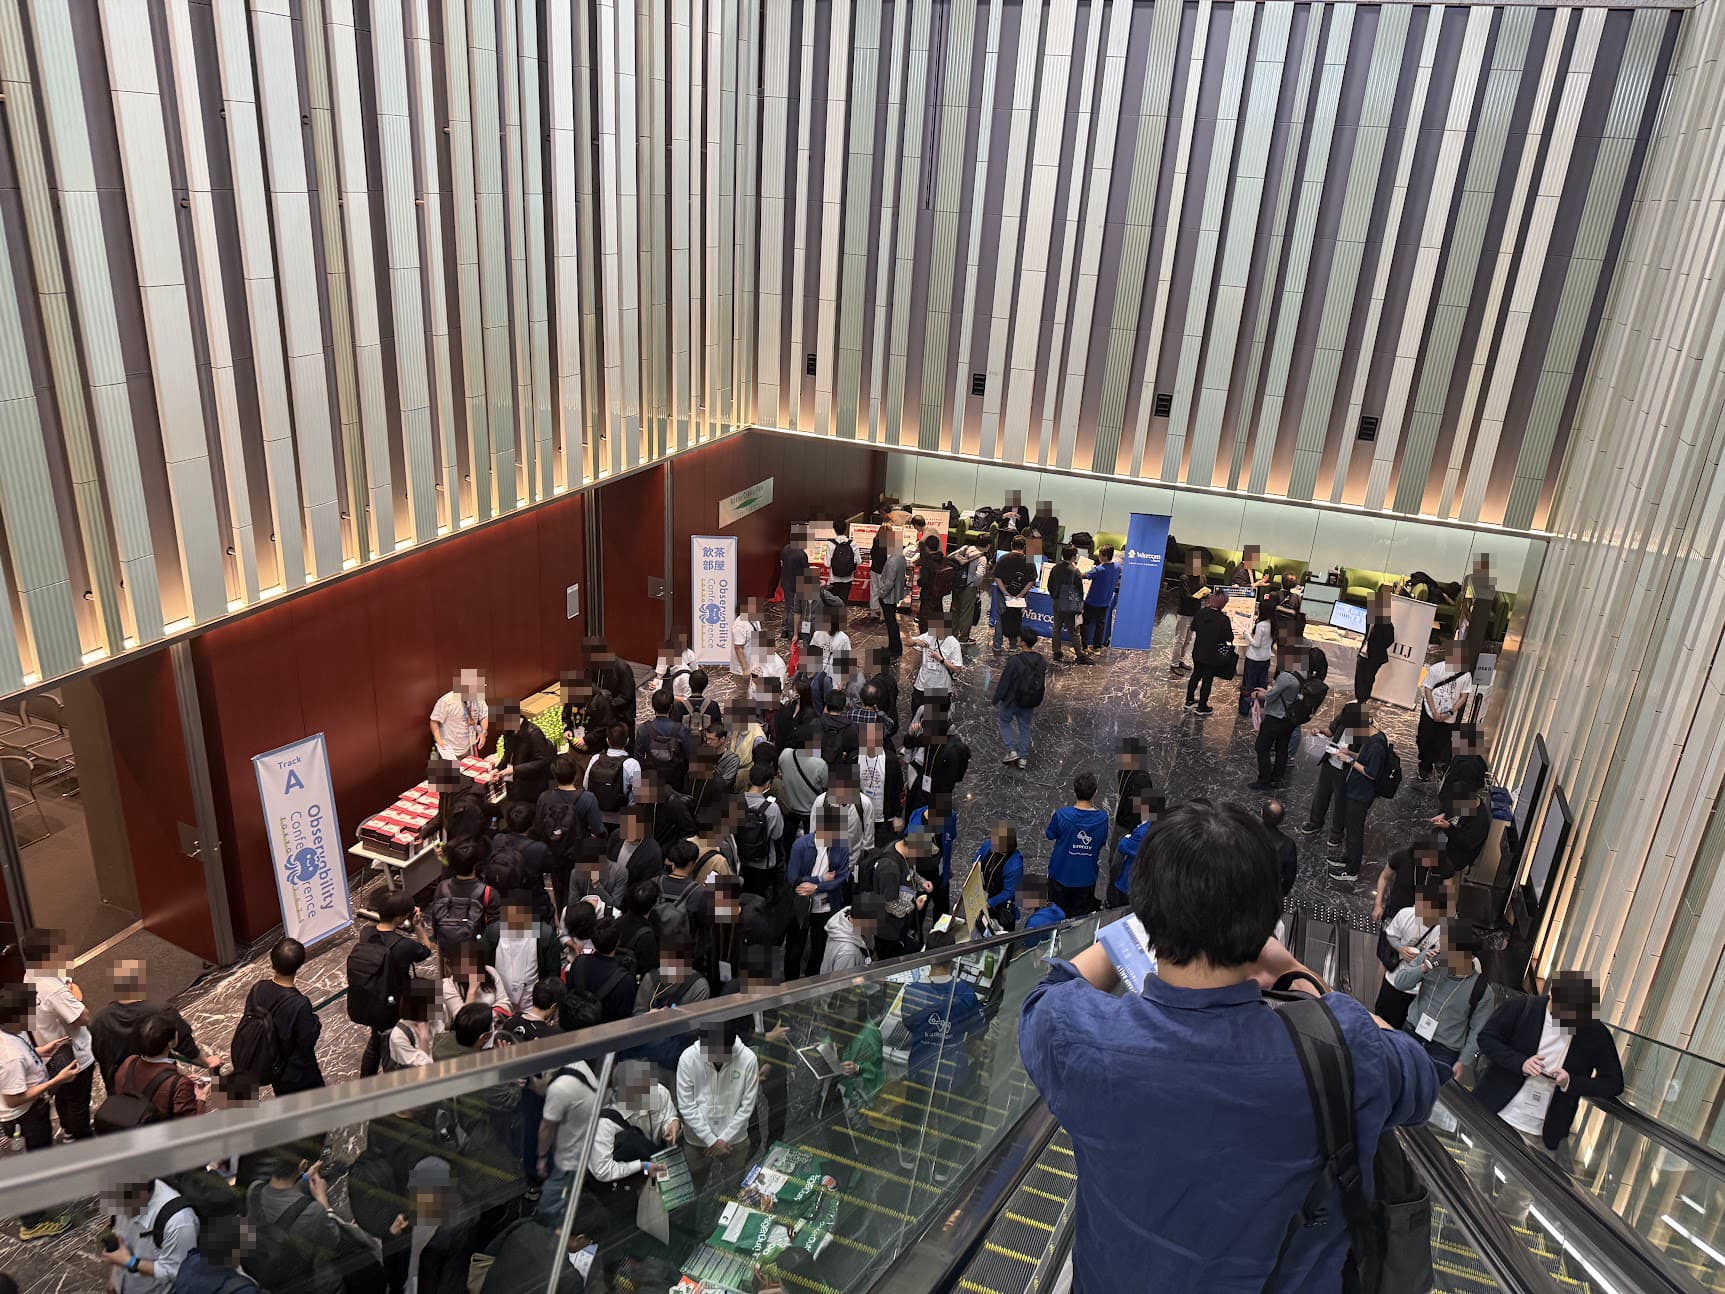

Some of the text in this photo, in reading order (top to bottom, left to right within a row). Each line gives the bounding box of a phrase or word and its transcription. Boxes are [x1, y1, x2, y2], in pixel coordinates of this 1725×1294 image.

[703, 546, 725, 558] 飲茶
[703, 560, 725, 571] 部屋
[717, 579, 728, 649] Observability
[1392, 642, 1412, 658] IIJ
[277, 756, 302, 770] Track
[284, 769, 304, 795] A
[307, 804, 334, 911] Observability
